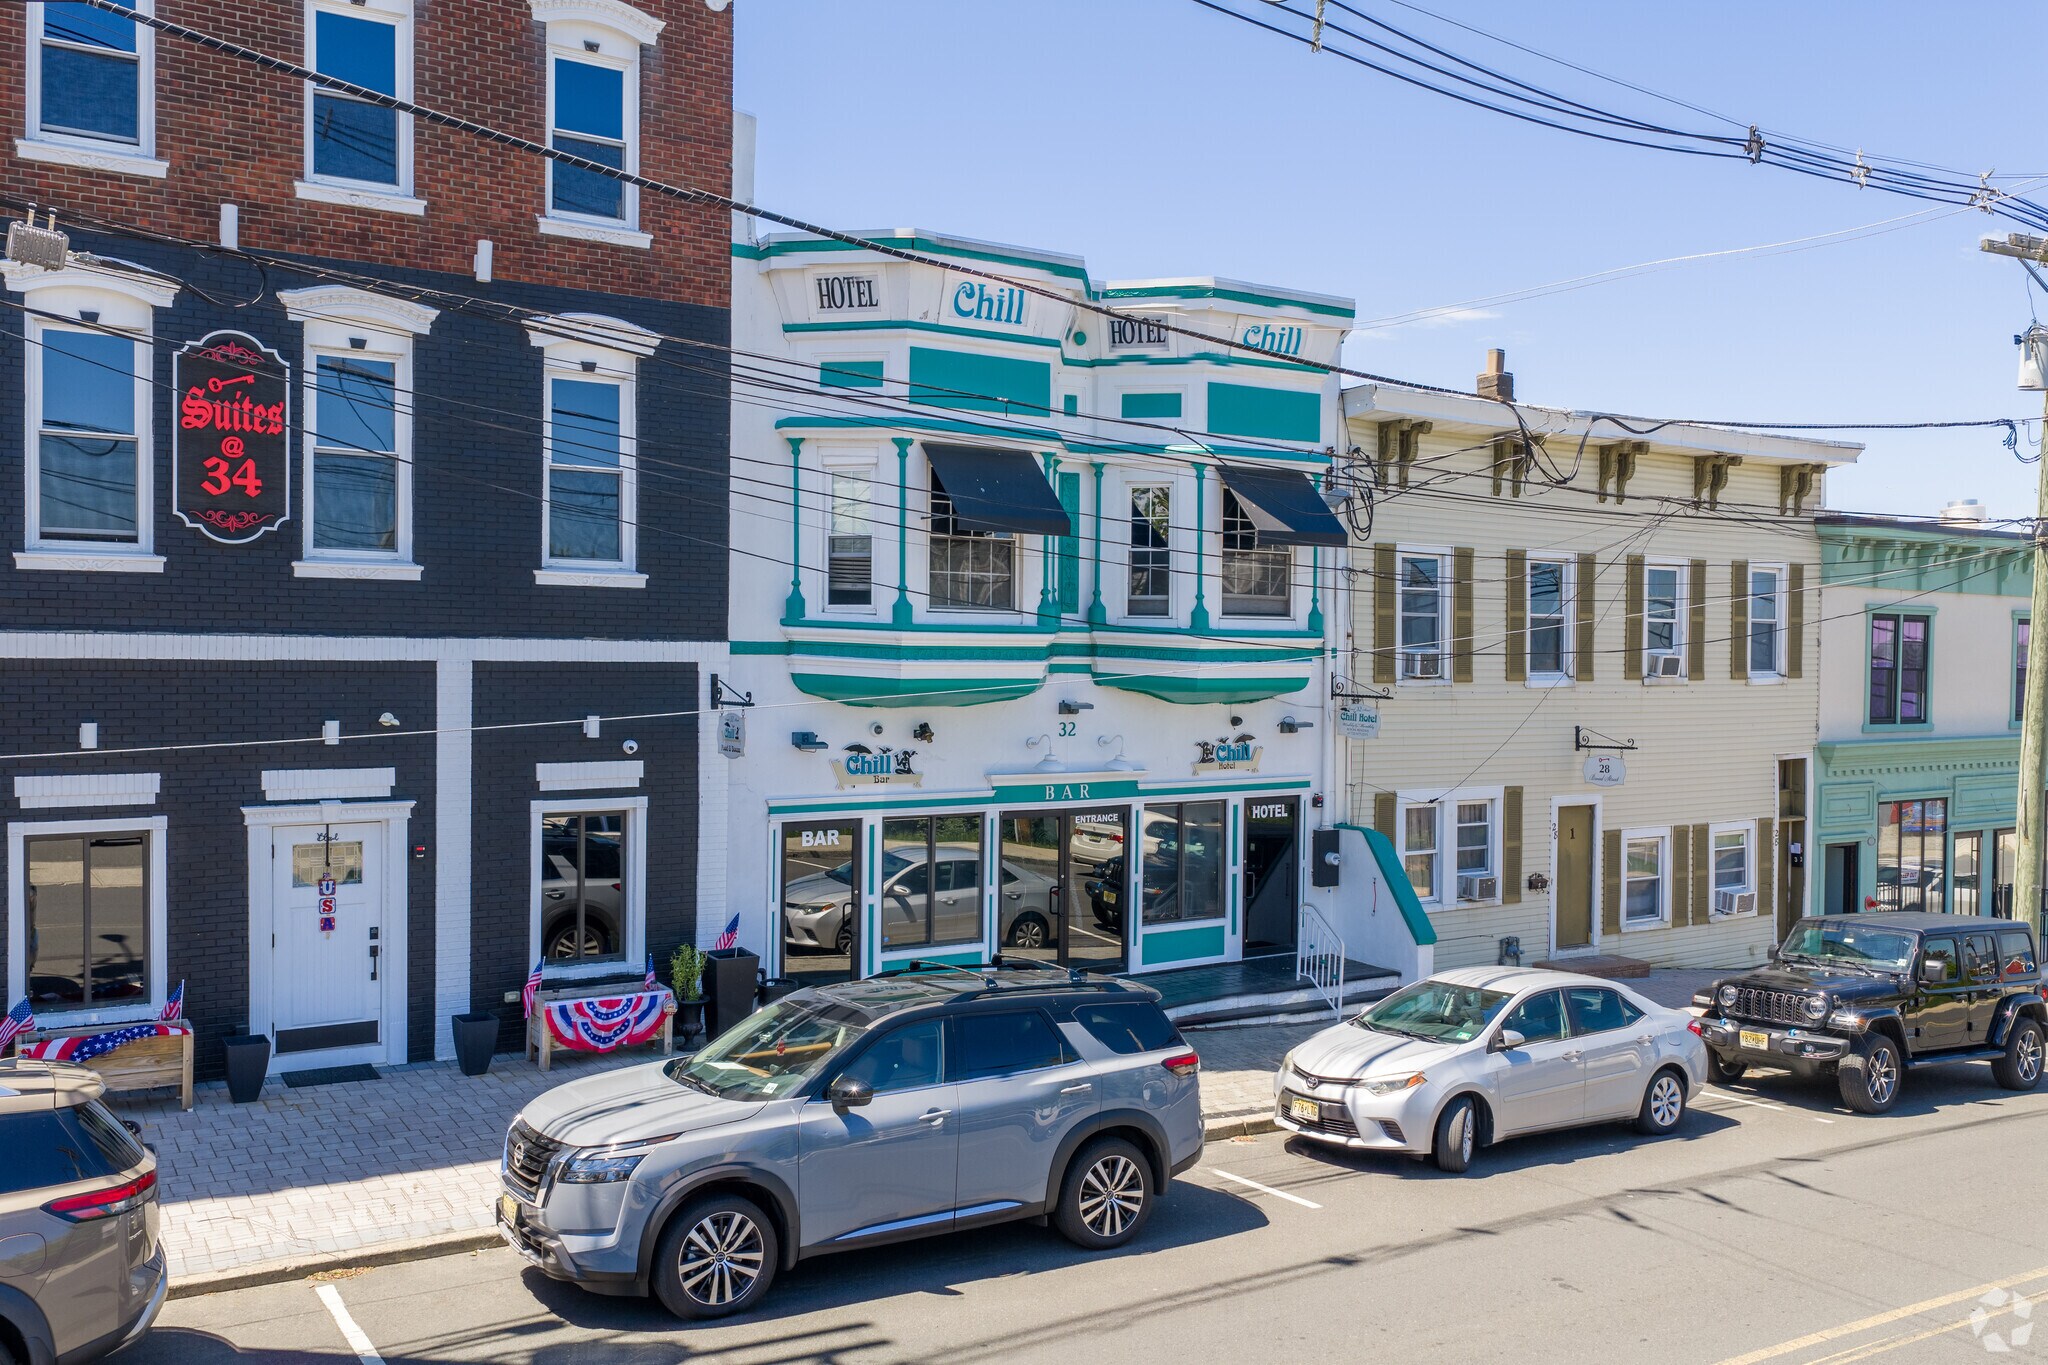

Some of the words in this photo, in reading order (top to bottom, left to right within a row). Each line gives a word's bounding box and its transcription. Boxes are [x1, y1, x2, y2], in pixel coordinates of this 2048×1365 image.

[817, 275, 879, 309] HOTEL
[952, 281, 1025, 325] Chill
[1109, 316, 1168, 344] HOTEL
[1242, 324, 1302, 355] Chill
[181, 387, 285, 435] Suites
[221, 436, 244, 458] @
[201, 457, 262, 498] 34
[1340, 712, 1357, 722] Chill
[1359, 713, 1377, 723] Hotel
[1058, 722, 1077, 737] 32
[1216, 742, 1251, 762] Chill
[846, 754, 891, 775] Chill
[1218, 762, 1236, 770] Hotel
[1599, 764, 1610, 774] 28
[873, 775, 890, 784] Bar
[1045, 784, 1090, 800] BAR
[1075, 813, 1119, 824] ENTRANCE
[1252, 804, 1288, 819] HOTEL
[801, 829, 839, 847] BAR
[1570, 827, 1576, 840] 1
